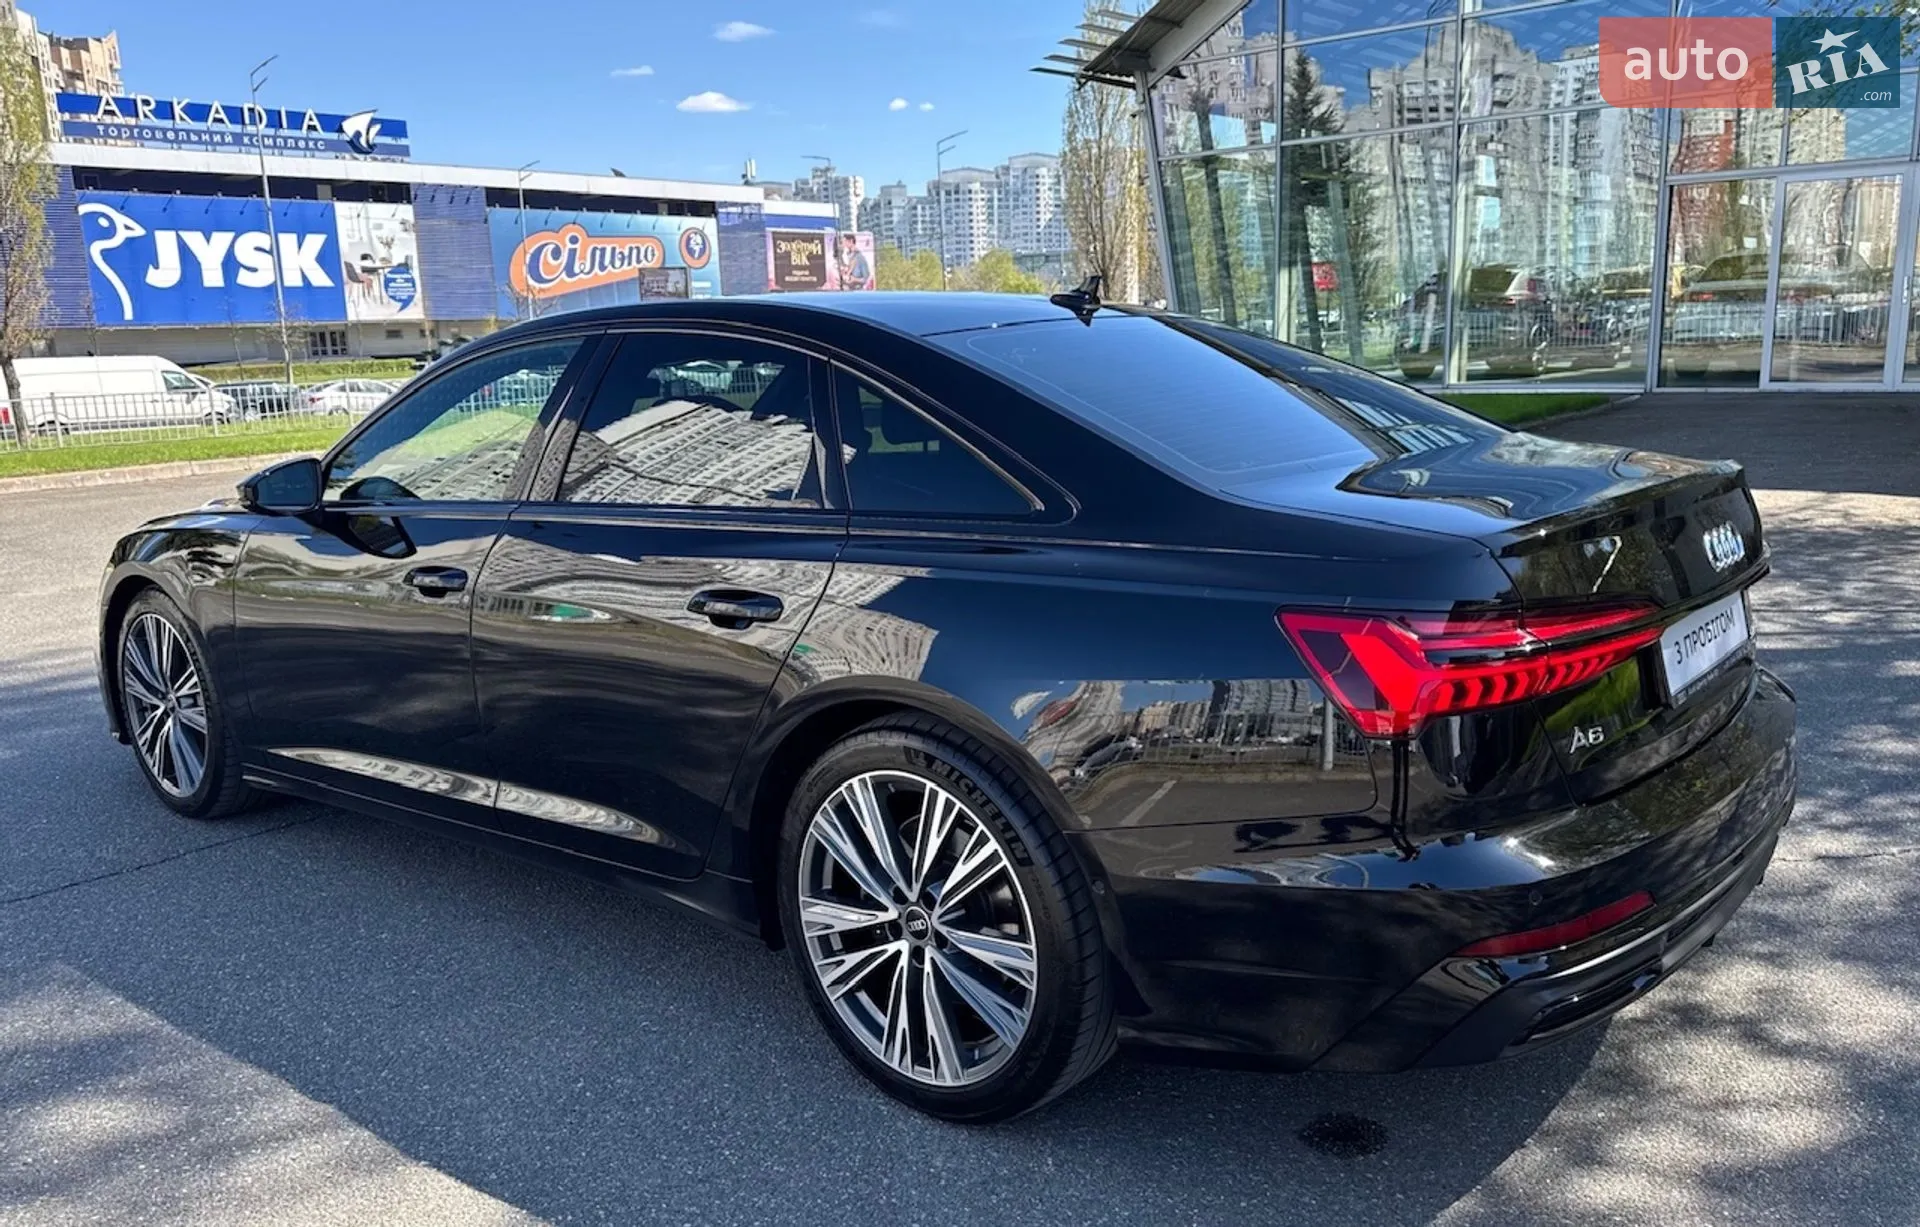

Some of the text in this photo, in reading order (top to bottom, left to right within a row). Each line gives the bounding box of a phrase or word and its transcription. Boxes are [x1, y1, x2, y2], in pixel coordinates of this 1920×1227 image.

[96, 124, 325, 150] торговельний комплекс
[98, 93, 324, 134] ARKADIA
[145, 229, 335, 289] JYSK
[526, 233, 657, 286] Сільпо
[1682, 607, 1735, 658] ПРОБІТОМ
[1569, 726, 1605, 754] A6
[931, 759, 1031, 863] MICHELIN
